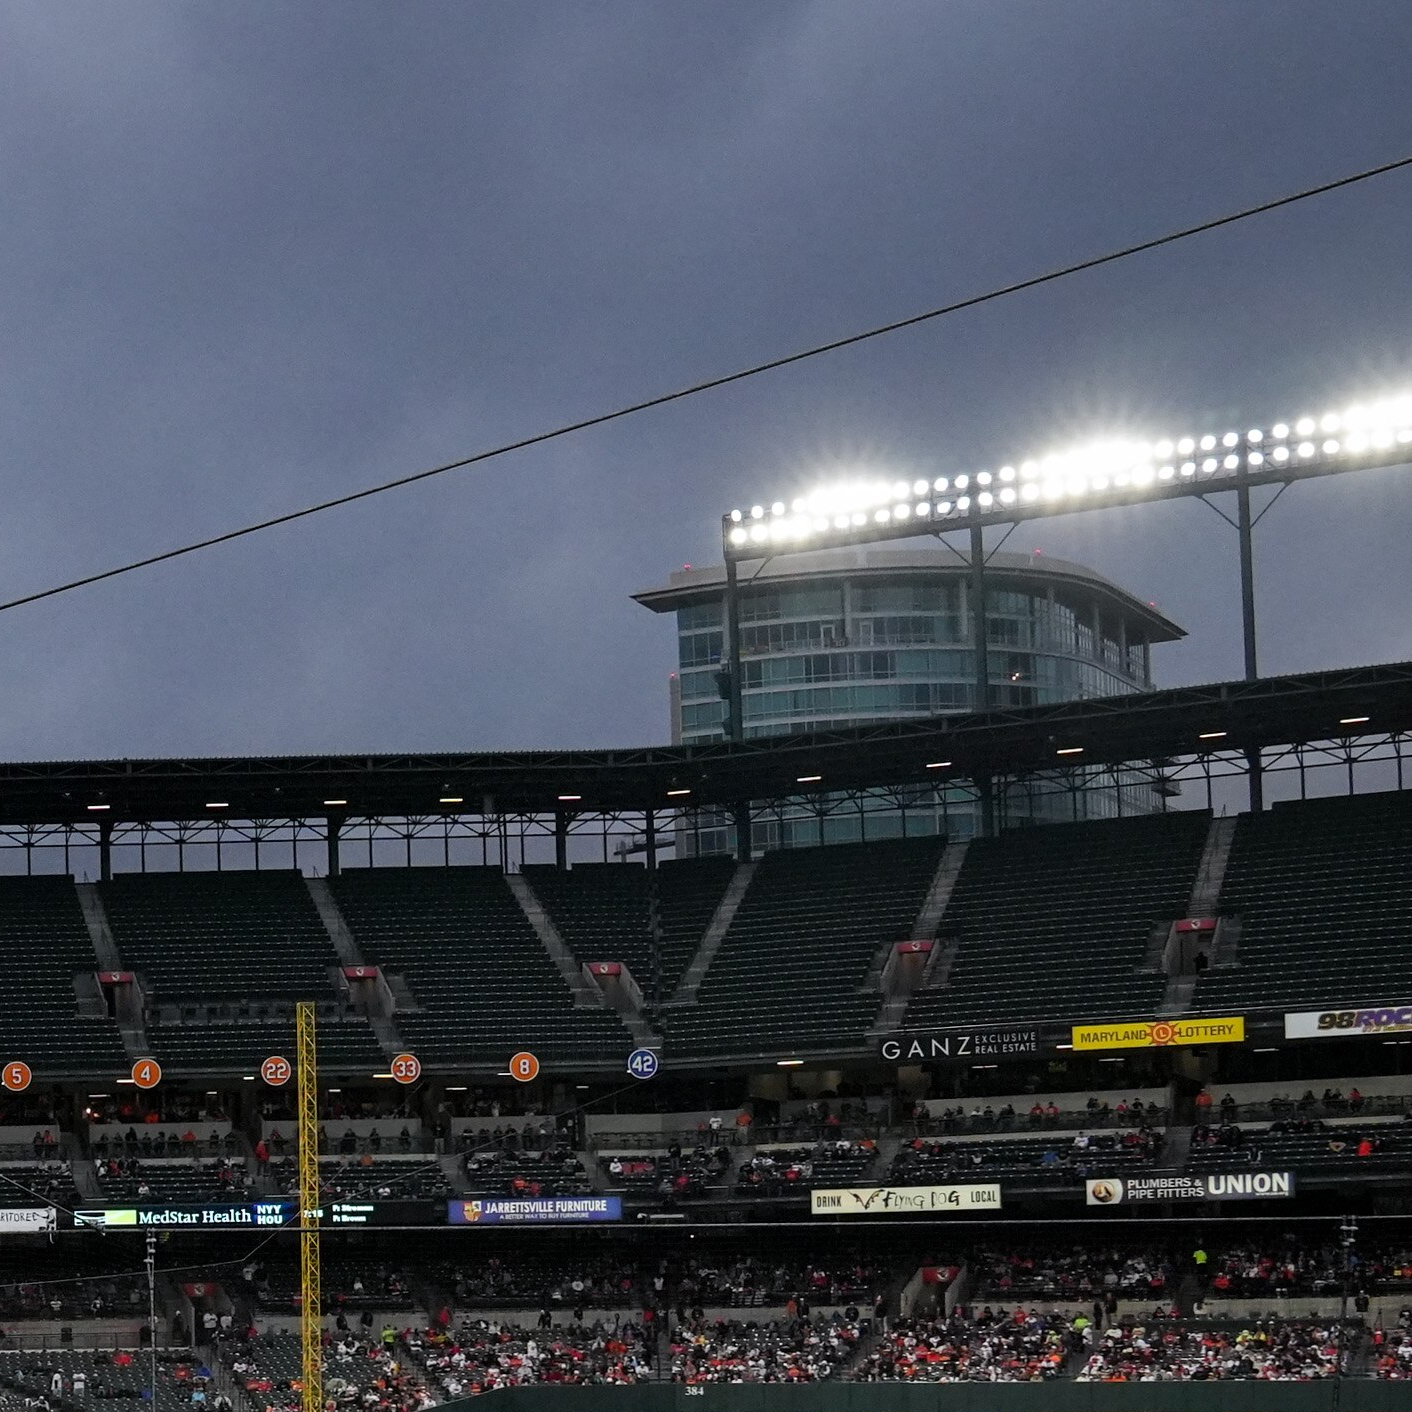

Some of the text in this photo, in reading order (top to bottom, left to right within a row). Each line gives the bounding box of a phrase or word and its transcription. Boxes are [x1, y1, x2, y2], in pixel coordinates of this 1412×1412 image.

[975, 1032, 1037, 1044] EXCLUSIVE
[1080, 1030, 1147, 1044] MARYLAND
[1178, 1025, 1234, 1038] LOTTERY
[882, 1036, 971, 1060] GANZ
[975, 1042, 1037, 1054] REAL ESTATE
[266, 1062, 286, 1079] 22
[395, 1060, 416, 1077] 33
[519, 1059, 530, 1075] 8
[632, 1055, 653, 1072] 42
[12, 1068, 22, 1084] 5
[140, 1065, 151, 1081] 4
[1127, 1177, 1191, 1189] PLUMBERS
[1194, 1178, 1202, 1186] &
[1207, 1172, 1290, 1195] UNION
[817, 1190, 997, 1208] DRINK FLYING DOG LOCAL
[1127, 1187, 1205, 1199] PIPE FITTERS
[257, 1205, 281, 1214] NYY
[485, 1200, 607, 1214] JARRETTSVILLE FURNITURE
[139, 1209, 252, 1224] MedStar Health
[257, 1215, 283, 1225] HOU
[685, 1386, 704, 1396] 384
